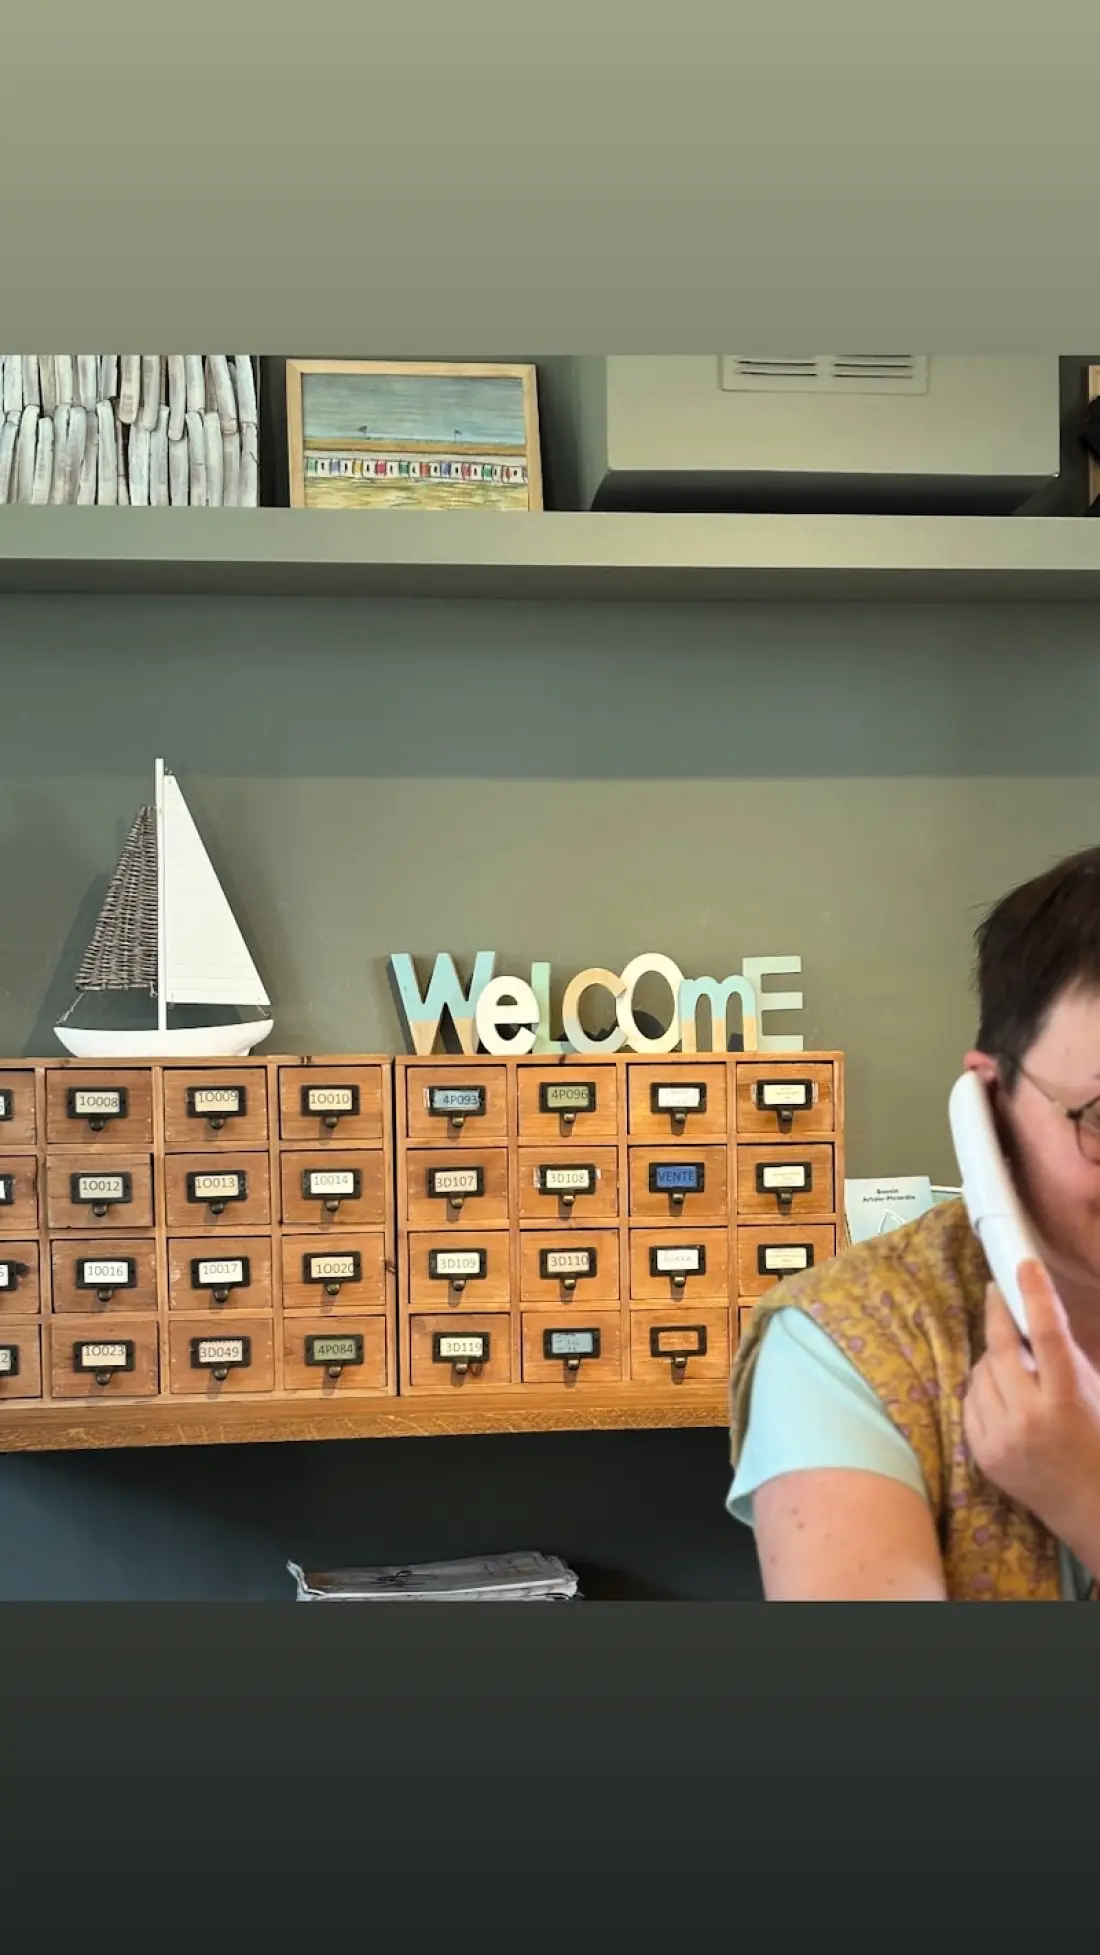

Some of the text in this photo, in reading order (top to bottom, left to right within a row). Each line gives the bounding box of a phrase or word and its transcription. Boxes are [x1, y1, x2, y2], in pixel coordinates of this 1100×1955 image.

[443, 1094, 478, 1105] 4P093
[552, 1089, 588, 1100] 4P096
[550, 1173, 585, 1184] 3D108
[658, 1170, 696, 1182] VENTE
[436, 1176, 474, 1188] 3D107
[440, 1258, 476, 1269] 3D109
[551, 1255, 588, 1267] 3D110
[199, 1346, 239, 1358] 3D049
[318, 1343, 353, 1355] 4P084
[446, 1342, 482, 1353] 3D119
